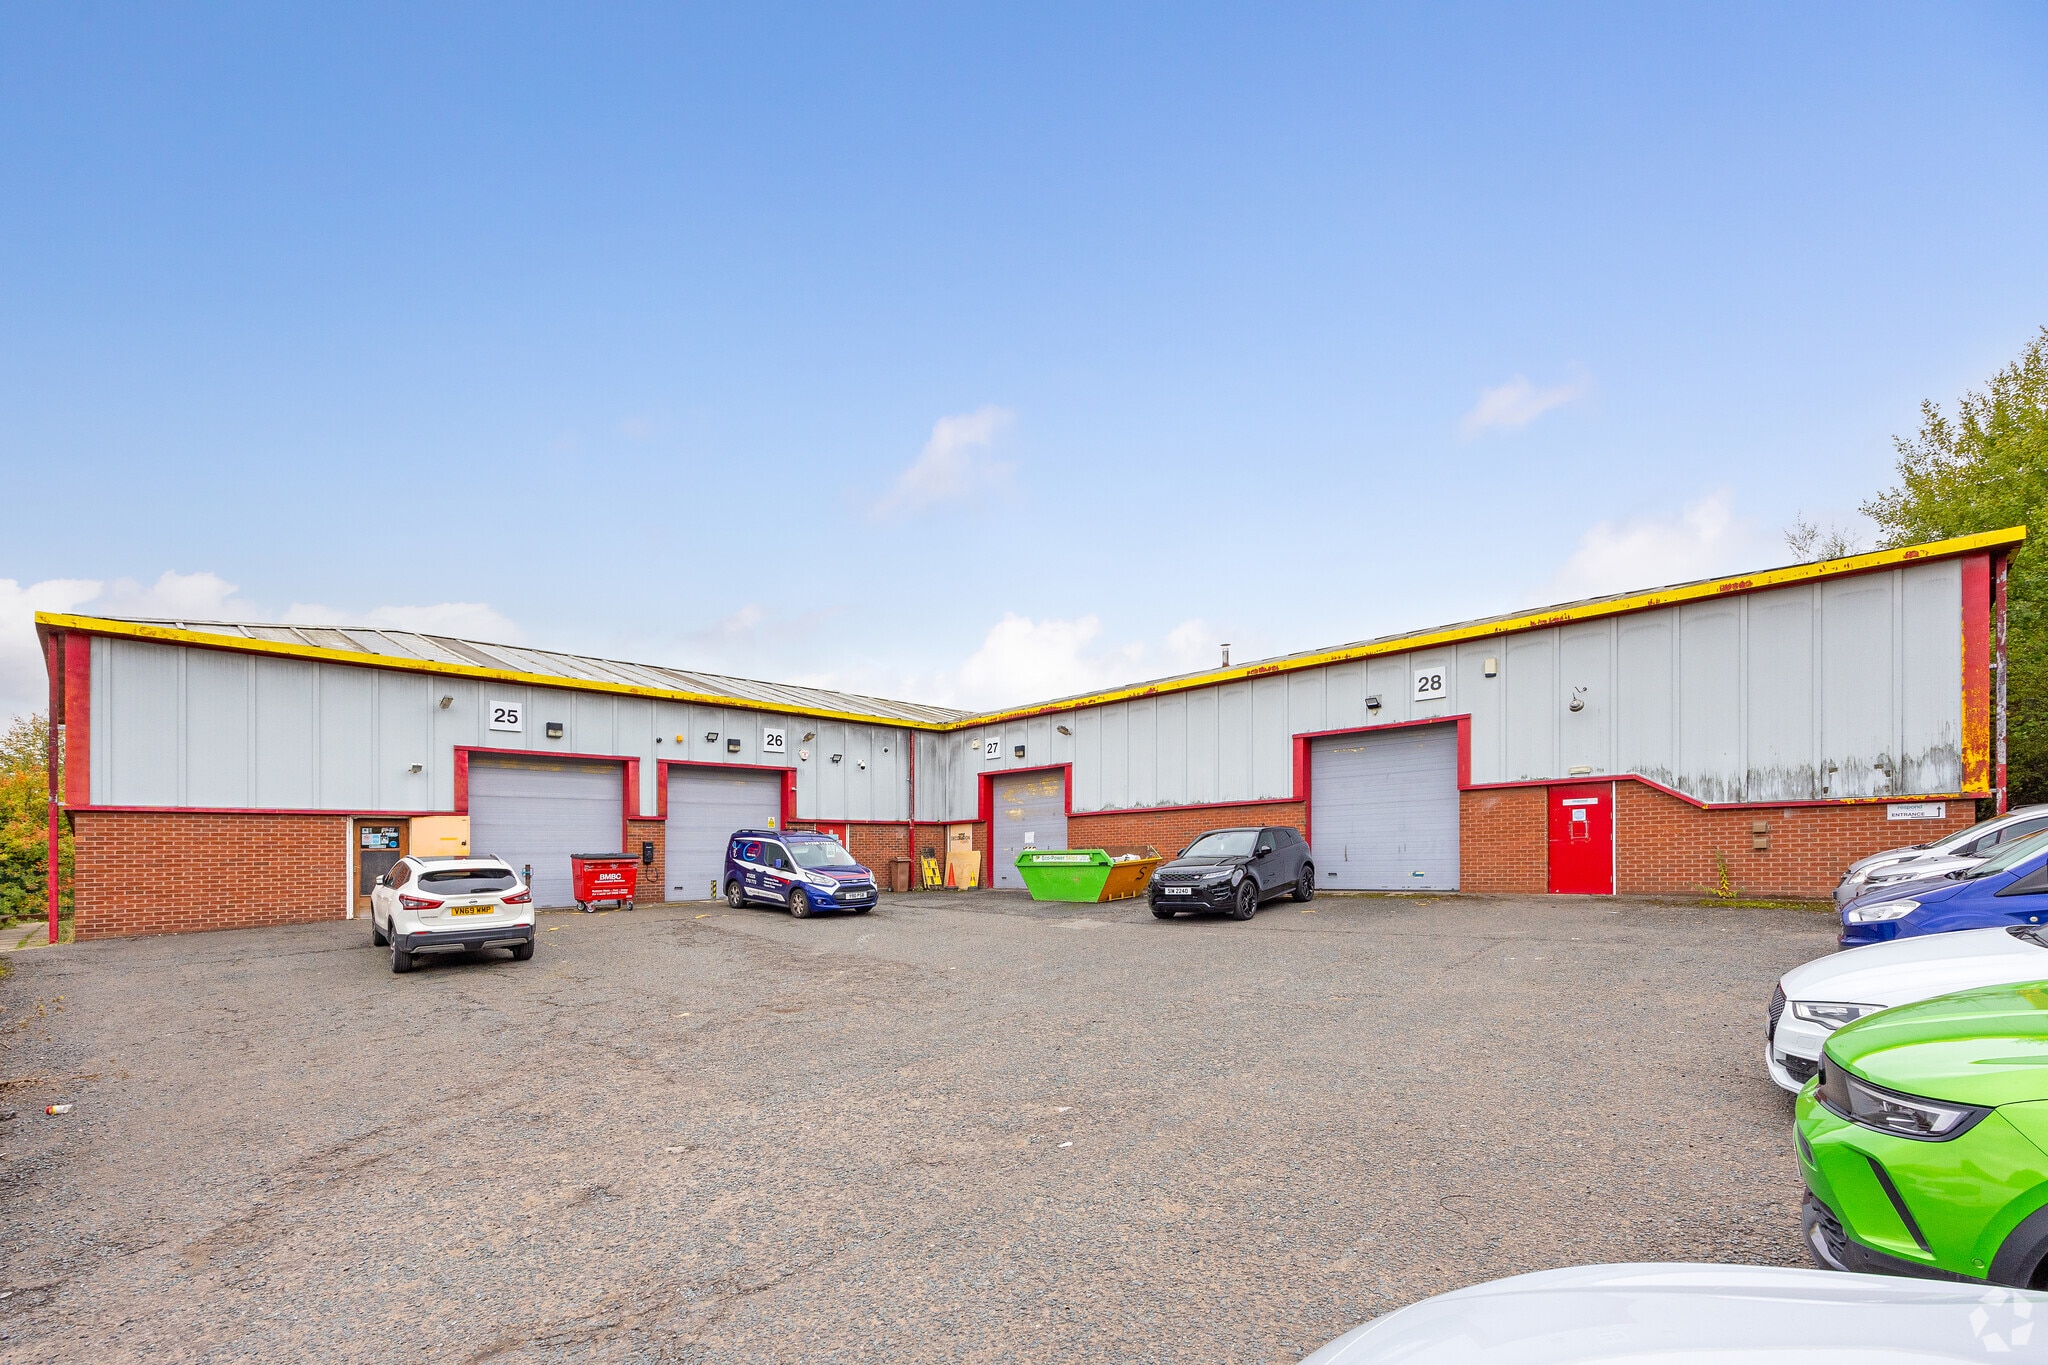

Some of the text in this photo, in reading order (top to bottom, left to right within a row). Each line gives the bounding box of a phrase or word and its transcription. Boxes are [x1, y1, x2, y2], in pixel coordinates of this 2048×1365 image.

[1418, 674, 1442, 693] 28
[494, 708, 519, 724] 25
[766, 733, 783, 747] 26
[987, 742, 998, 754] 27
[454, 905, 491, 915] VN69 WMP
